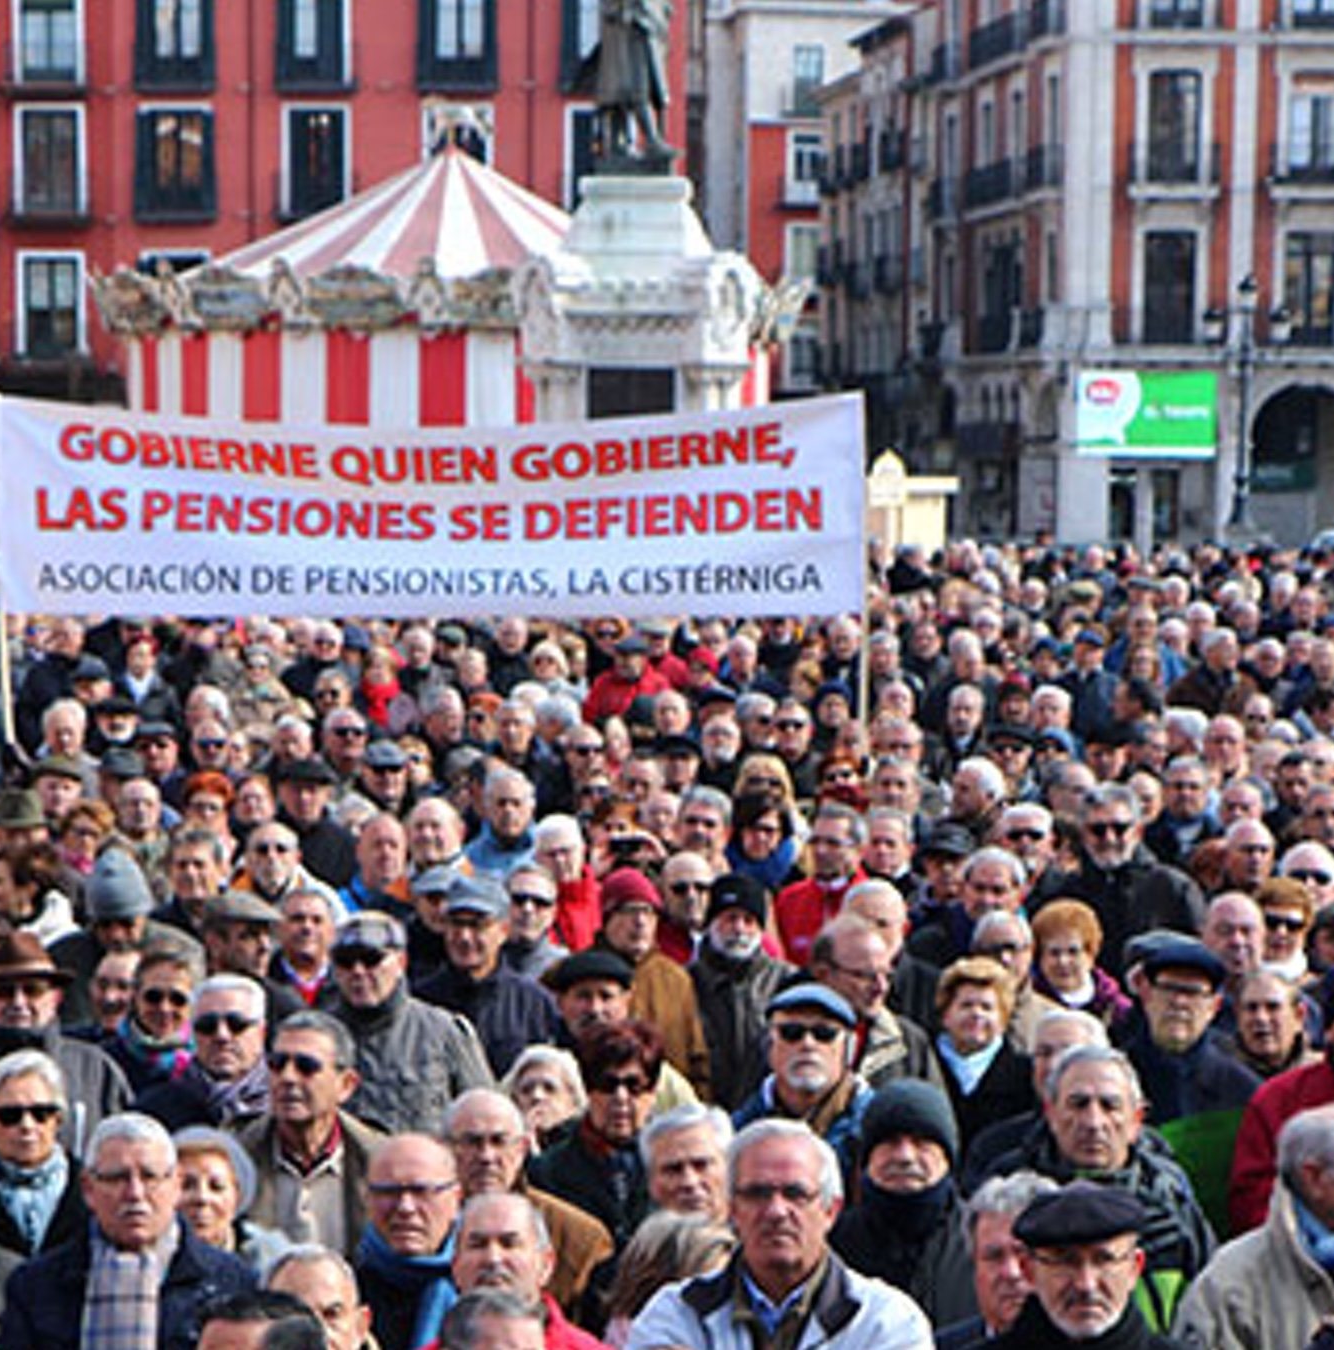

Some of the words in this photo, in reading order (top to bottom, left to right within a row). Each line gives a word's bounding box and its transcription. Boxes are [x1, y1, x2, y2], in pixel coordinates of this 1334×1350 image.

[58, 423, 319, 481] GOBIERNE
[330, 446, 498, 487] QUIEN
[511, 422, 797, 482] GOBIERNE,
[35, 486, 128, 532] LAS
[141, 490, 435, 541] PENSIONES
[449, 503, 510, 541] SE
[522, 487, 822, 541] DEFIENDEN
[38, 562, 241, 595] ASOCIACIÓN
[250, 565, 295, 595] DE
[305, 566, 557, 599] PENSIONISTAS,
[568, 567, 610, 595] LA
[618, 561, 822, 596] CISTÉRNIGA
